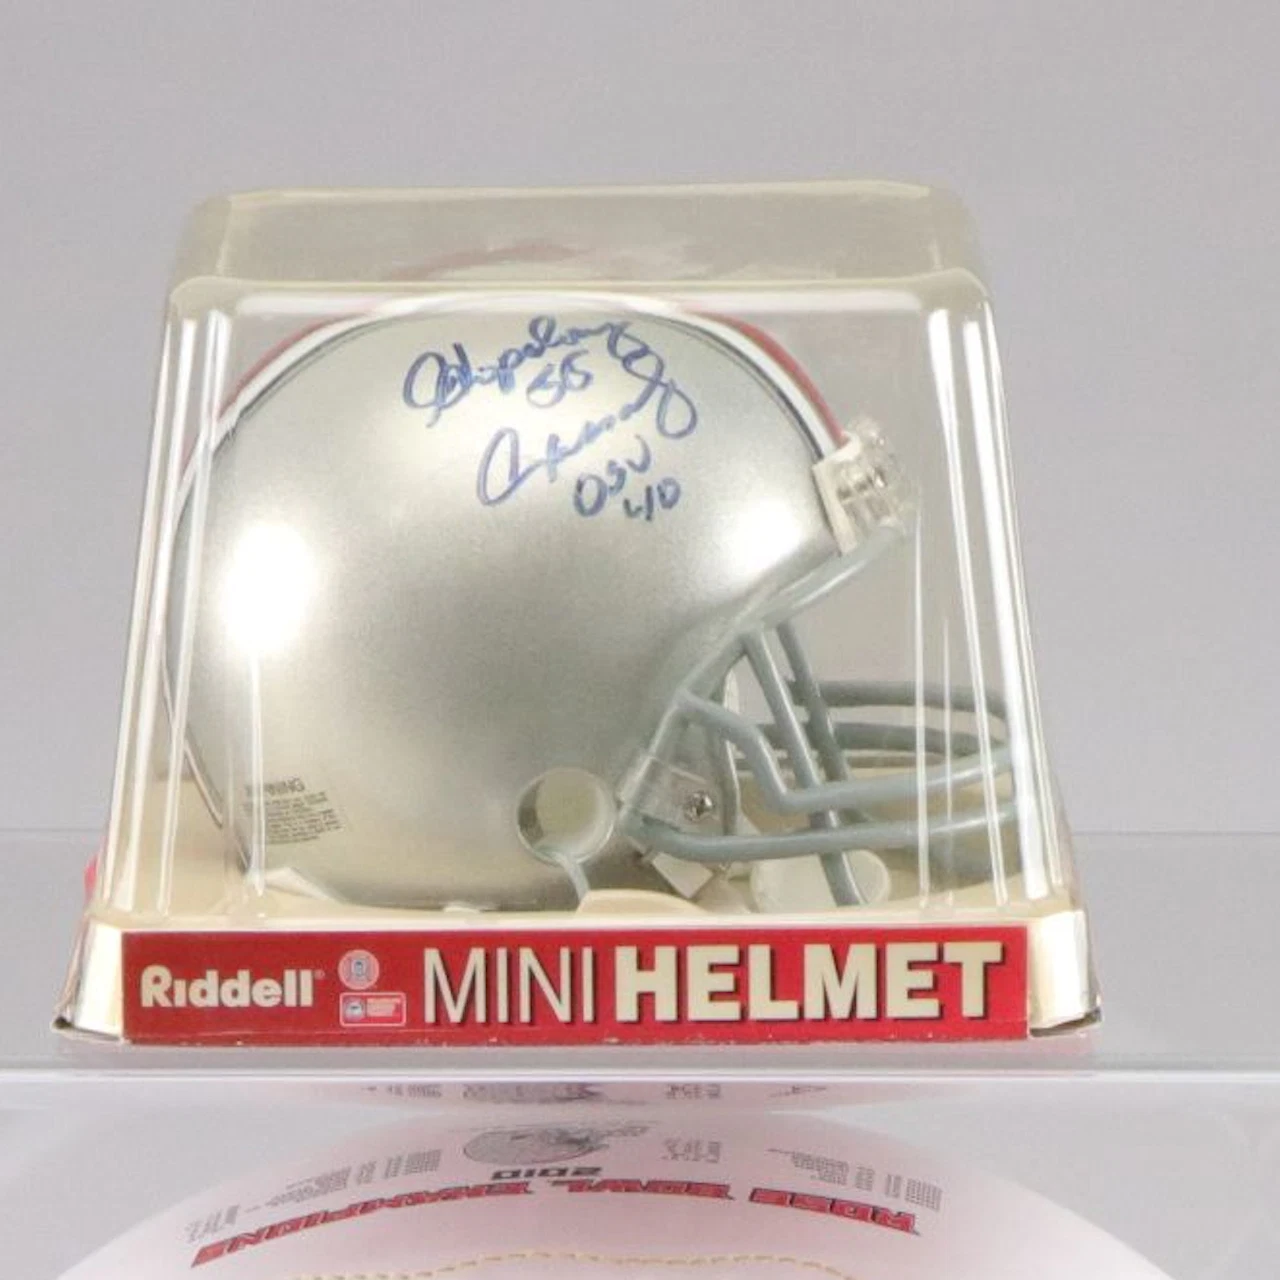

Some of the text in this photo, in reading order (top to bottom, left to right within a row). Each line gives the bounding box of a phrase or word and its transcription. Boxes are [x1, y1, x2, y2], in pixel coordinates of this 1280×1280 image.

[140, 964, 315, 1008] Riddell
[423, 946, 595, 1025] MINI
[614, 941, 1004, 1022] HELMET
